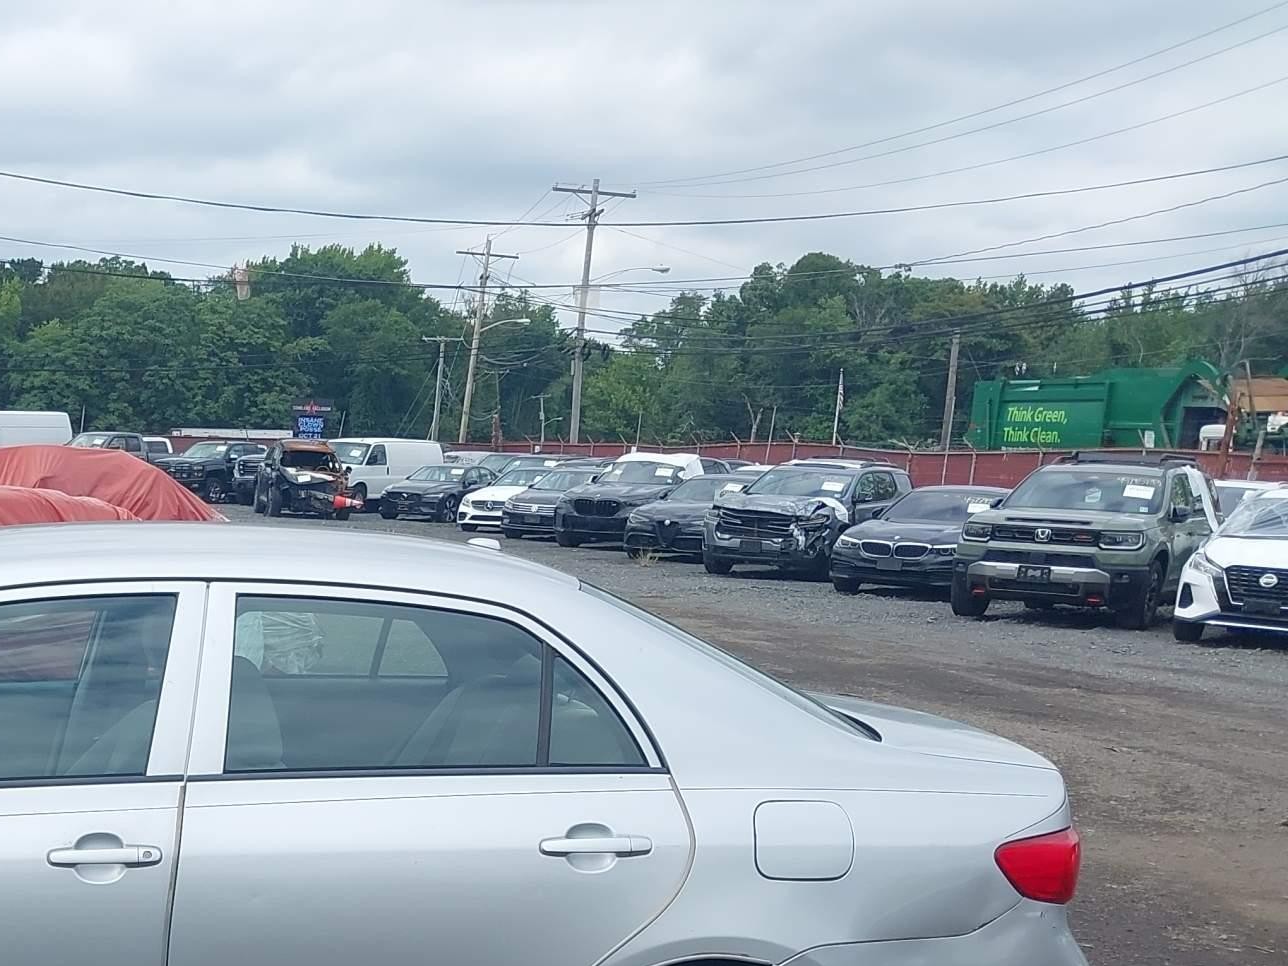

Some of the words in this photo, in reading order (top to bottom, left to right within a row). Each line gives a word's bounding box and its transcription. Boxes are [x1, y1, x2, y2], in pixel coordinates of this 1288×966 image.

[1007, 406, 1032, 423] Think
[1034, 407, 1068, 425] Green,
[1003, 427, 1029, 443] Think
[1030, 427, 1061, 443] Clean.
